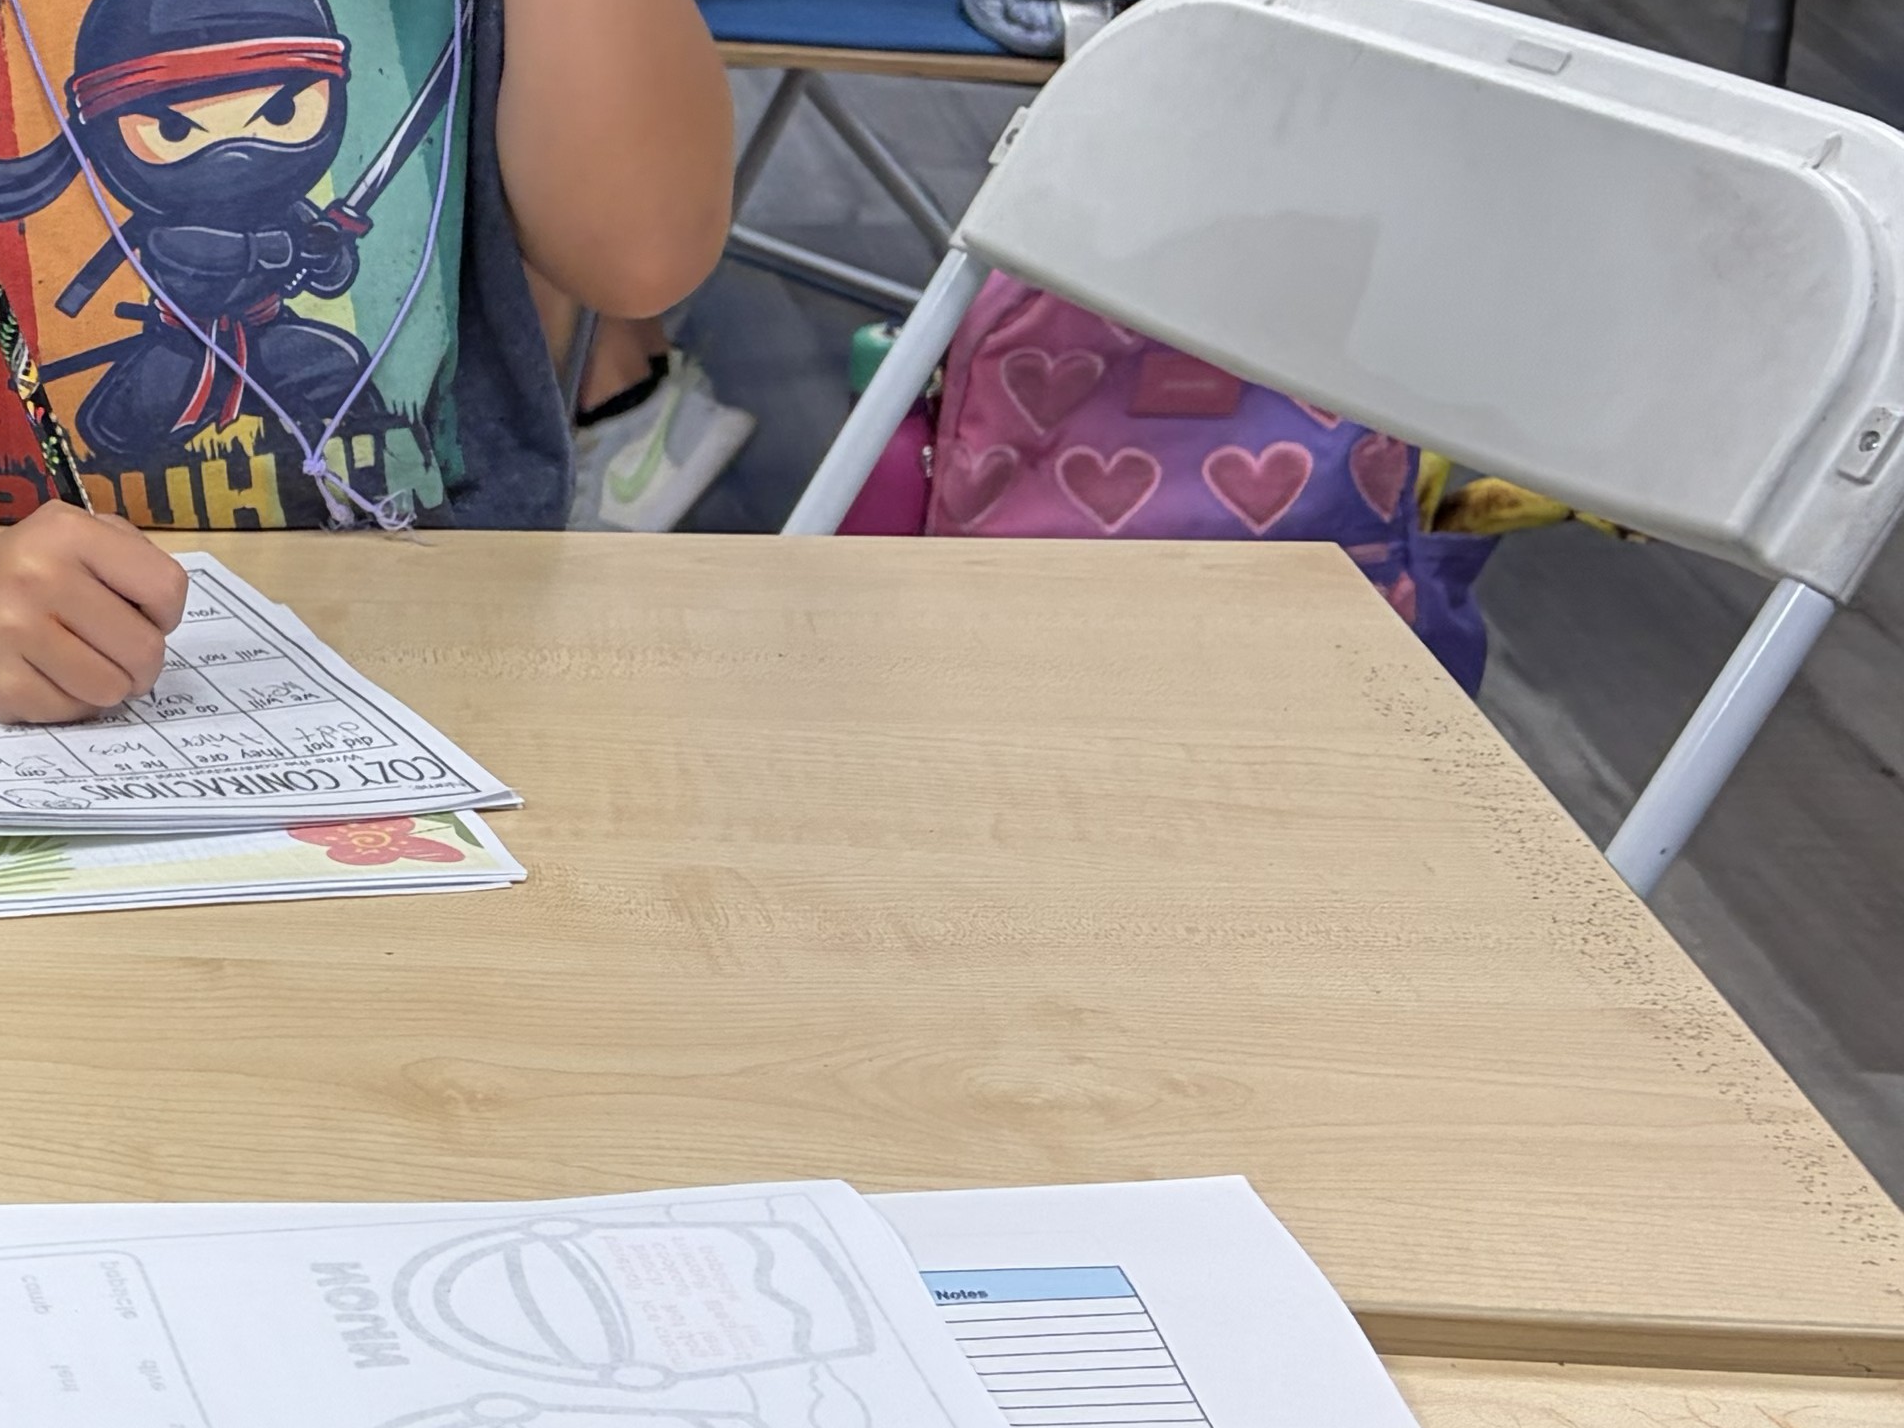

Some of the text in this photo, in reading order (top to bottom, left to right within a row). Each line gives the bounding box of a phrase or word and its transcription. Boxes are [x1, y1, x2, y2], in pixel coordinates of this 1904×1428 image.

[198, 649, 276, 666] will not
[156, 704, 218, 720] do not
[304, 736, 382, 754] did not
[196, 748, 289, 762] they are
[140, 760, 169, 769] he
[72, 754, 446, 800] COZY CONTRACTIONS
[935, 1288, 988, 1301] Notes
